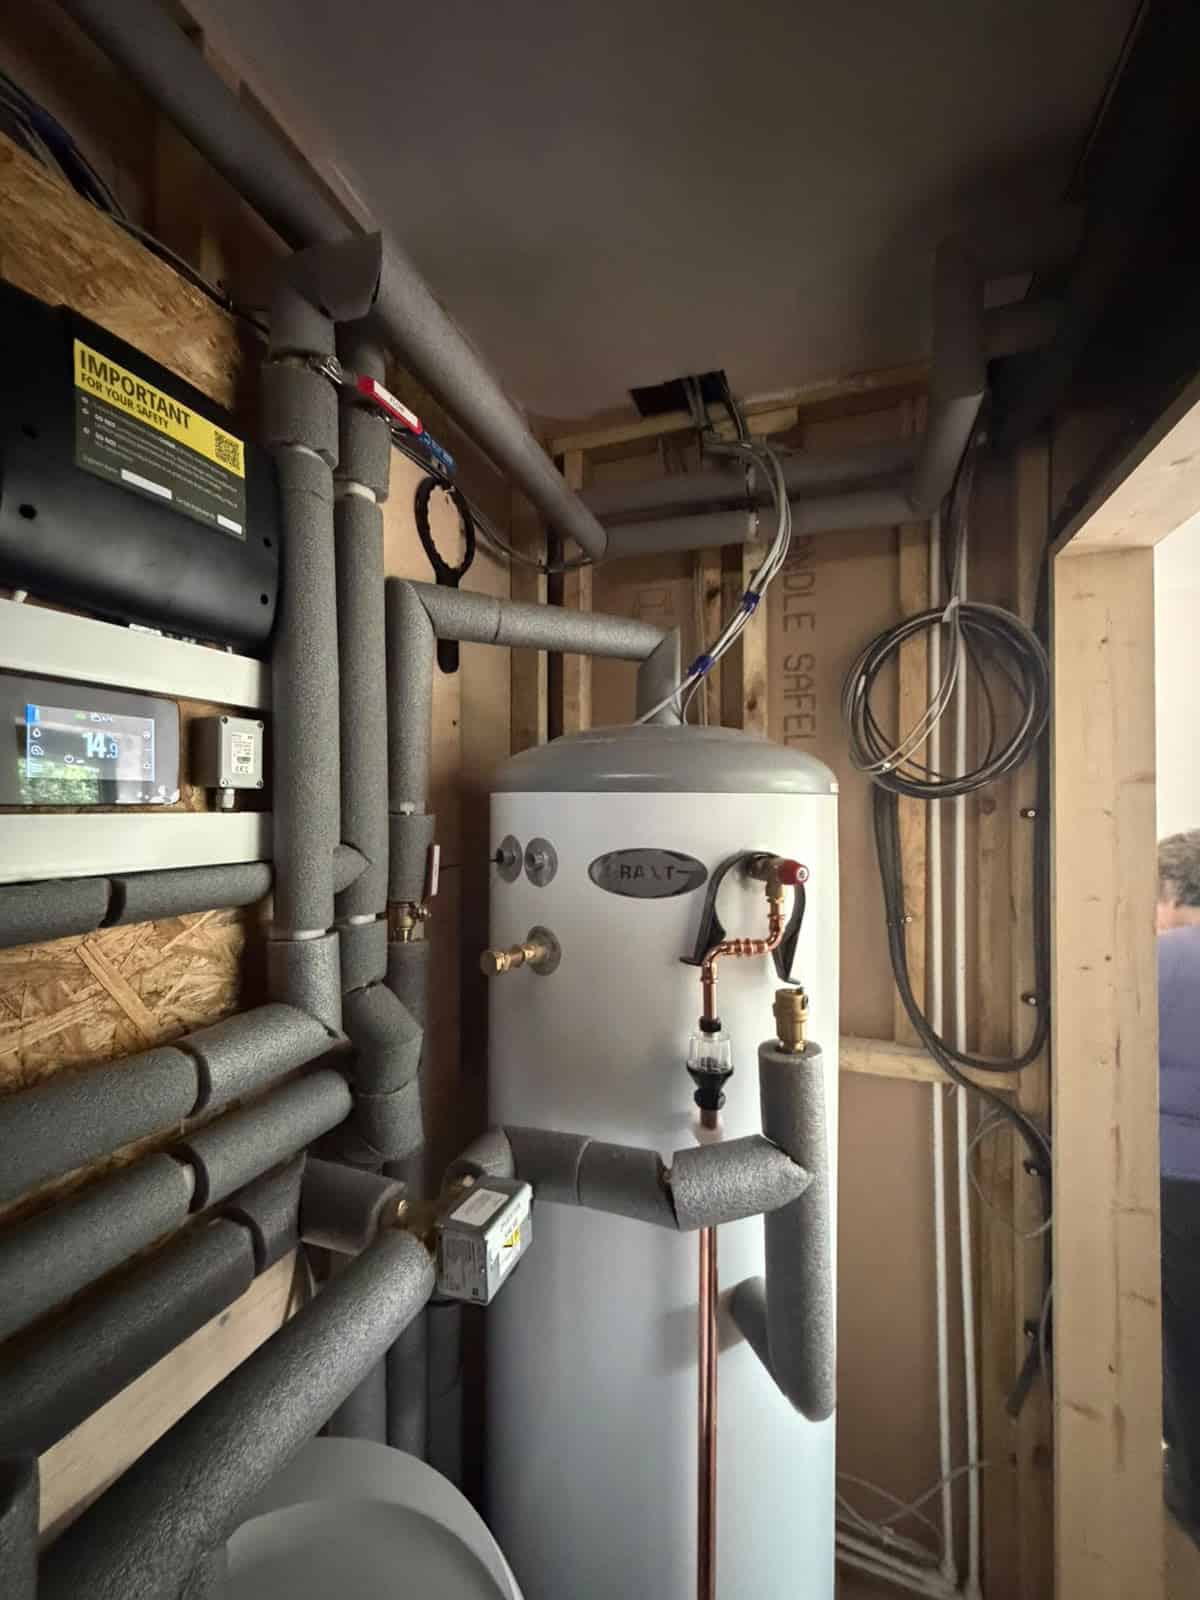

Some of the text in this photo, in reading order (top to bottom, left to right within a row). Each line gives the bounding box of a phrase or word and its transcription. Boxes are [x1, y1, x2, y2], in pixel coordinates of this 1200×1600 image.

[81, 349, 191, 429] IMPORTANT
[81, 372, 168, 430] FOR YOUR SAFETY
[82, 731, 118, 760] 14.9
